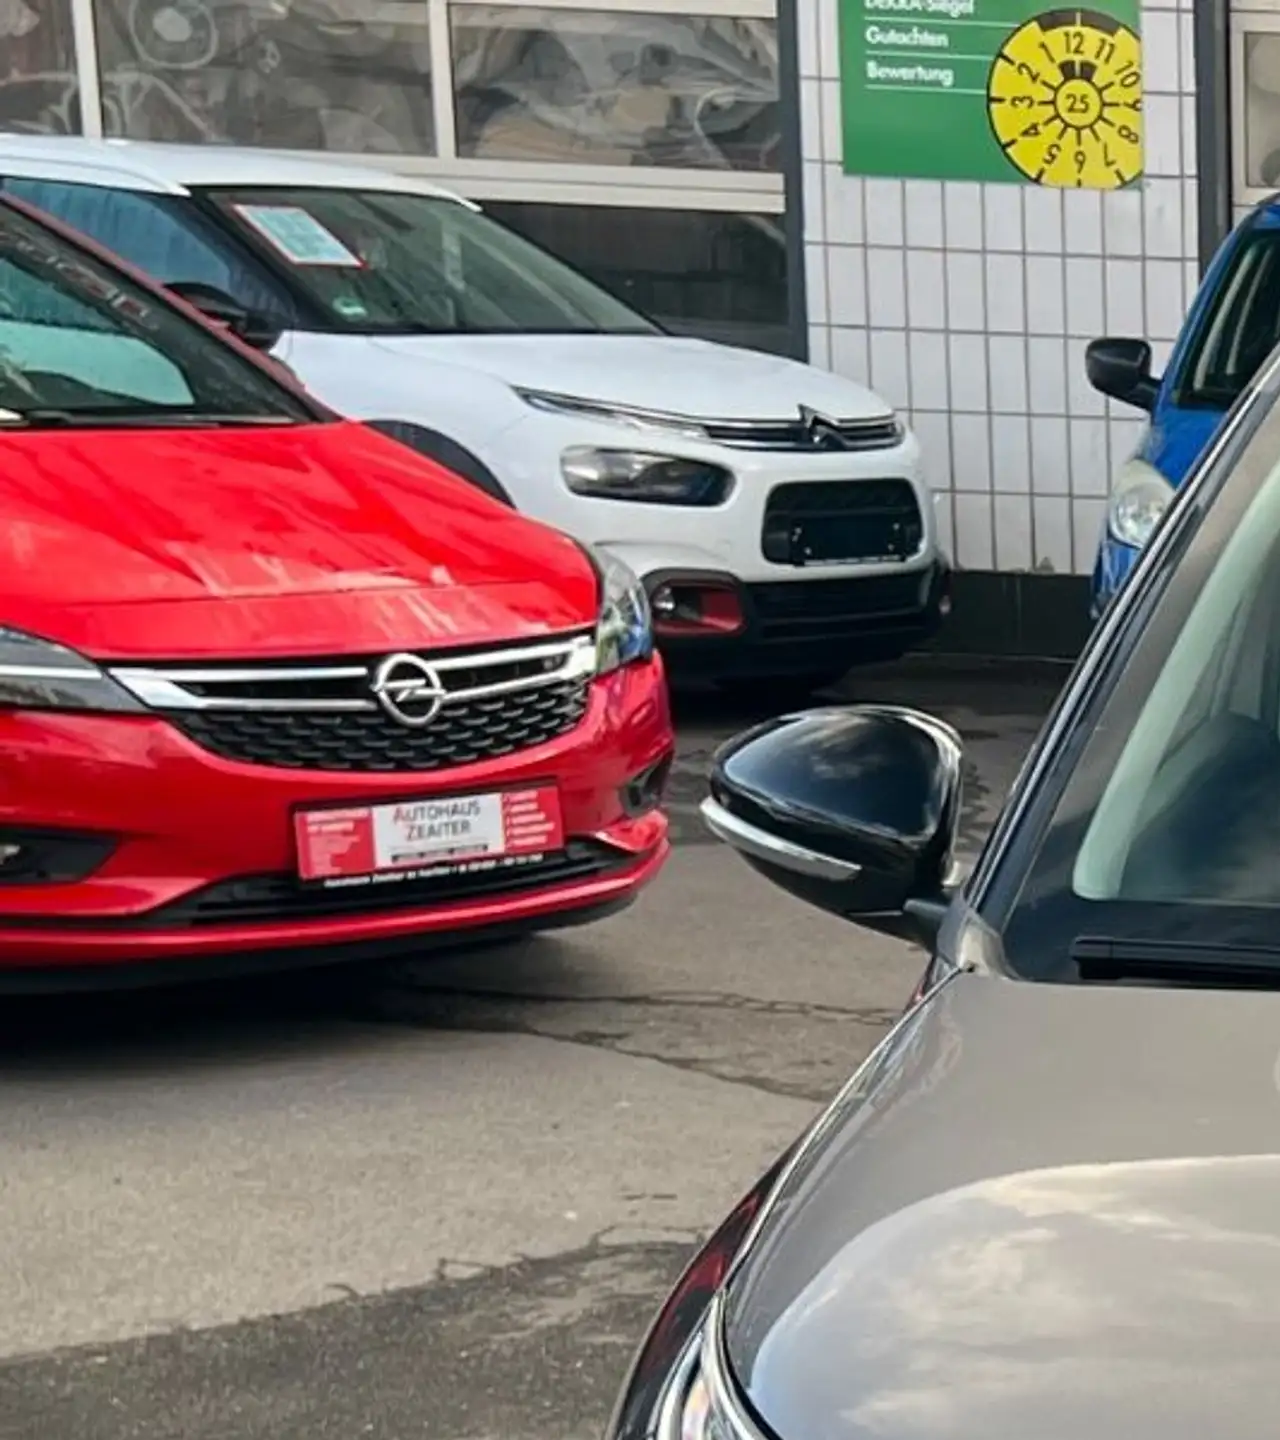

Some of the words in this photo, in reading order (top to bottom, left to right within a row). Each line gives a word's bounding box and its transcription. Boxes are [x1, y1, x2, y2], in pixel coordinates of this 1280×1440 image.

[865, 26, 949, 47] Gutachten
[1063, 32, 1084, 55] 12
[1094, 39, 1115, 64] 11
[866, 60, 954, 87] Bewertung
[1065, 93, 1089, 114] 25
[393, 801, 481, 824] AUTOHAUS
[407, 820, 471, 841] ZEAITER
